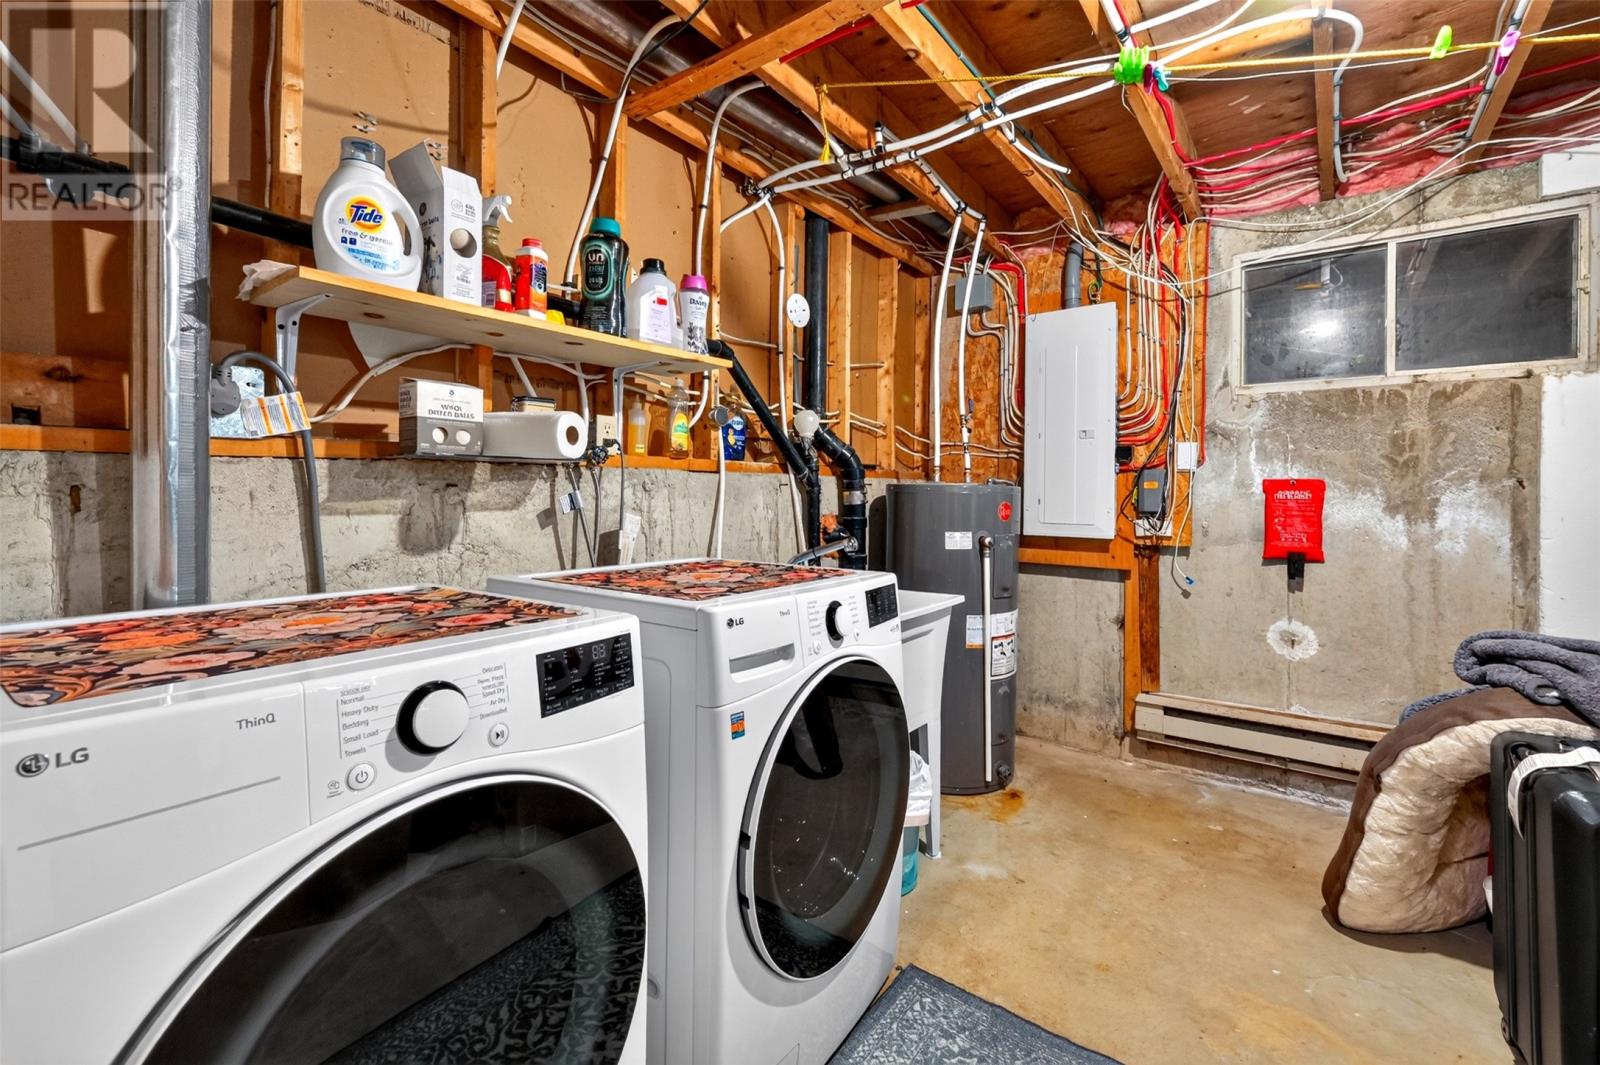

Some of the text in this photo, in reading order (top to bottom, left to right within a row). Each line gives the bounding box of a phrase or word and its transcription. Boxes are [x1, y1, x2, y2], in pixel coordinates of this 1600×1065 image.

[350, 204, 383, 224] Tide
[341, 227, 358, 237] free
[441, 404, 462, 412] WOOL
[428, 409, 475, 420] DRYER BALLS
[735, 617, 744, 626] LG
[341, 695, 365, 705] Normal
[341, 705, 379, 718] Heavy Duty
[236, 713, 276, 730] ThinQ
[342, 720, 369, 731] Bedding
[343, 729, 379, 744] Small Load
[55, 747, 89, 768] LG
